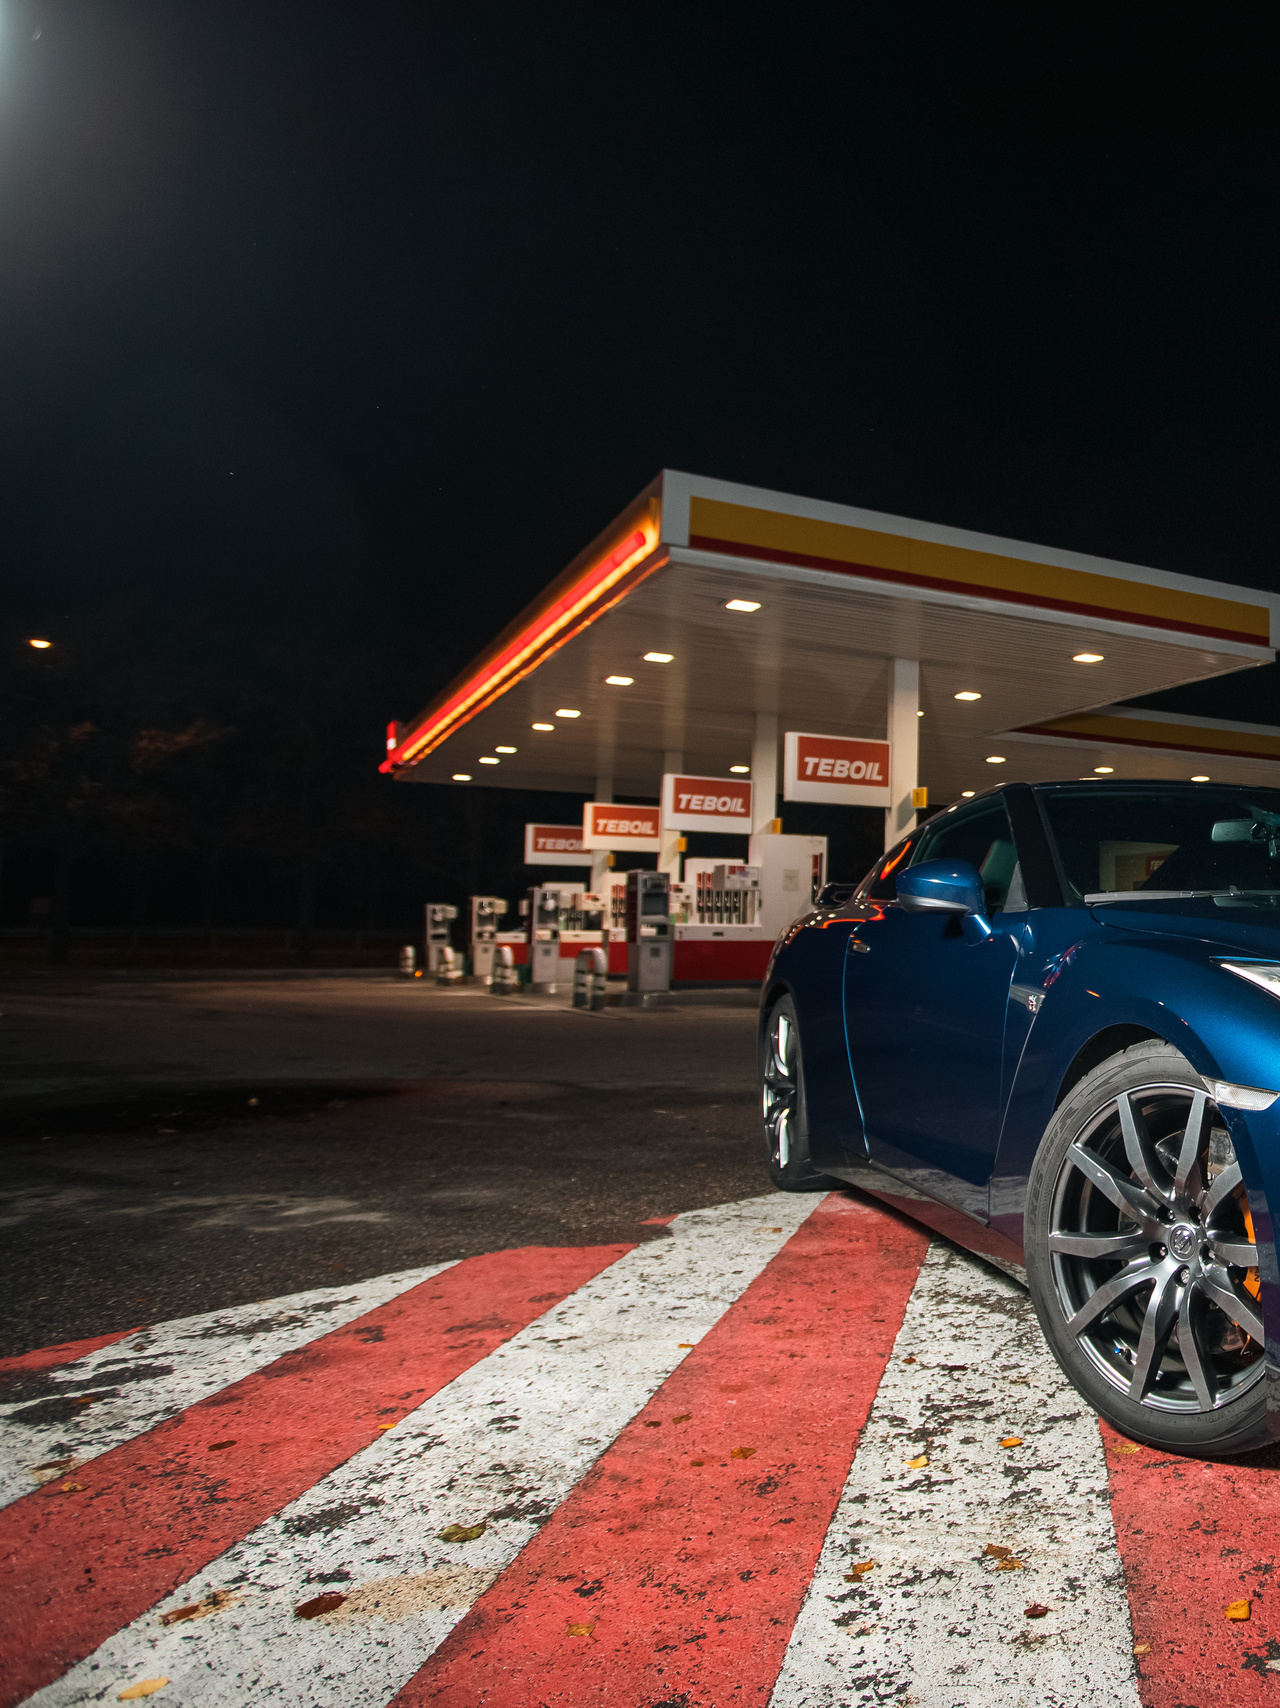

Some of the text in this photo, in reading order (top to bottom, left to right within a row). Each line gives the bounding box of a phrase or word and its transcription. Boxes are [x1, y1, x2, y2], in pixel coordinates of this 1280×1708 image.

[803, 756, 883, 781] TEBOIL
[678, 793, 746, 813] TEBOIL
[596, 819, 656, 835] TEBOIL
